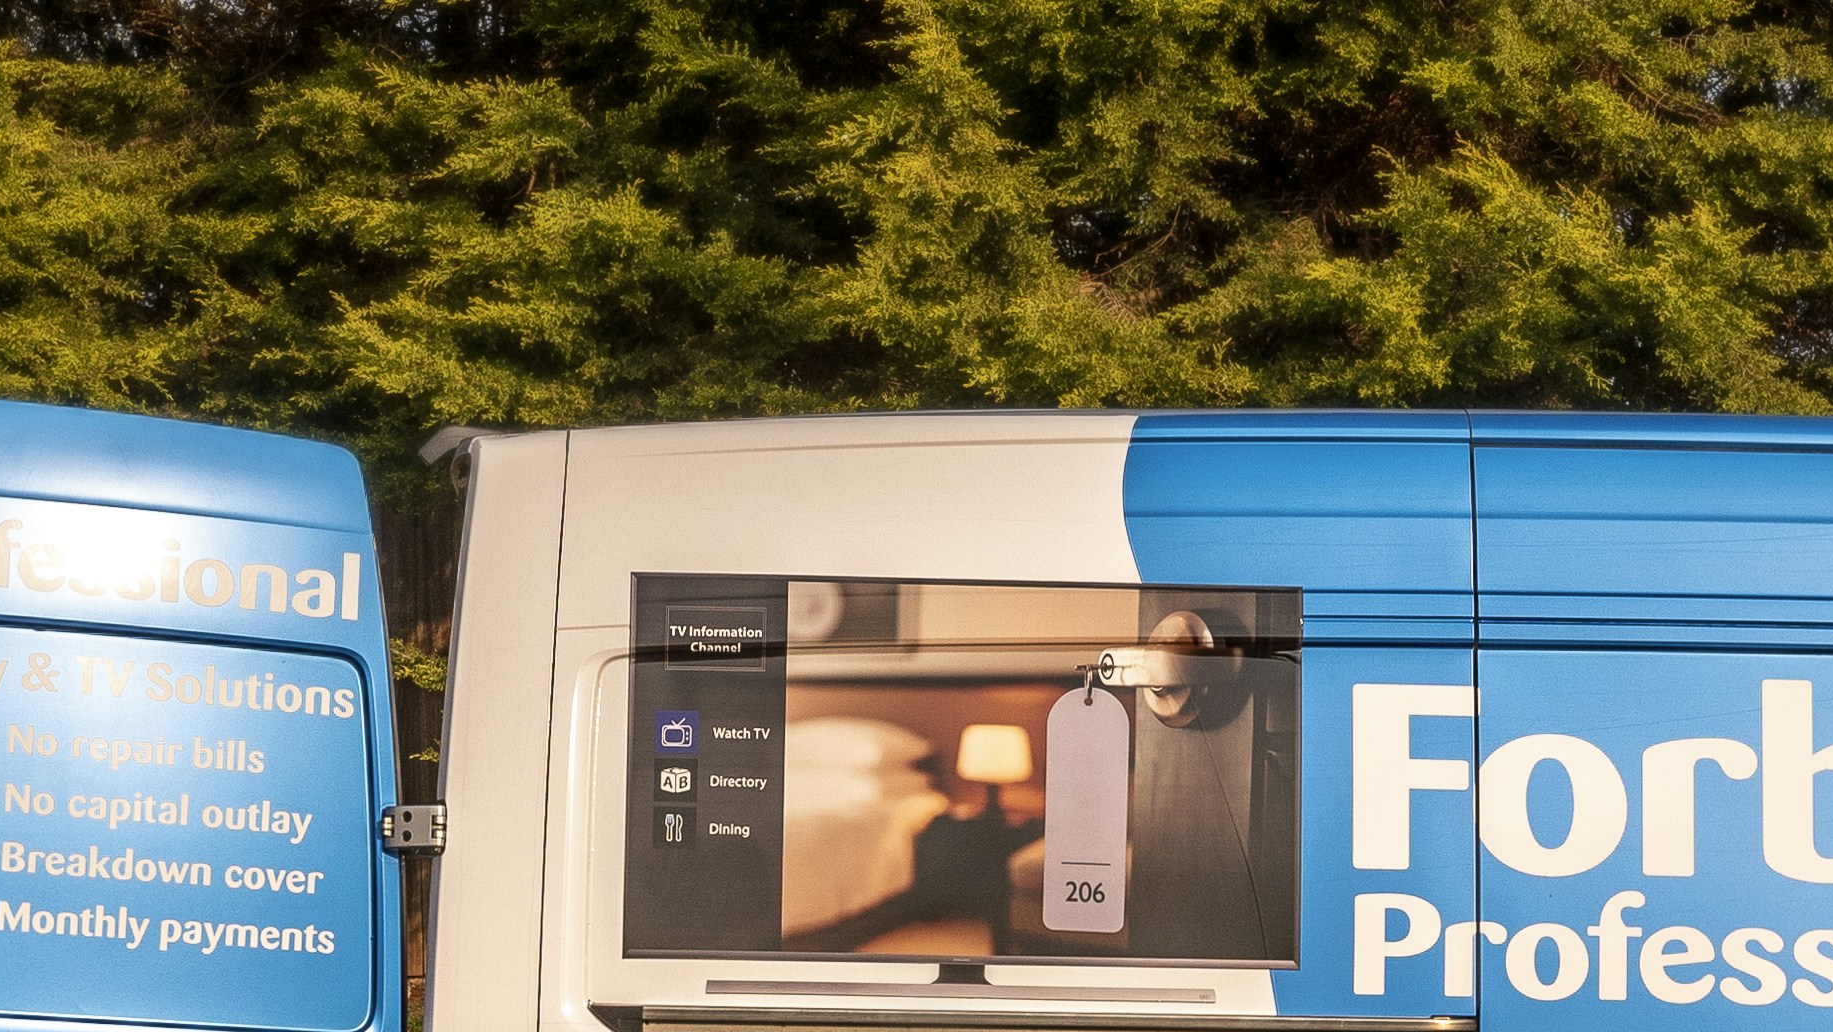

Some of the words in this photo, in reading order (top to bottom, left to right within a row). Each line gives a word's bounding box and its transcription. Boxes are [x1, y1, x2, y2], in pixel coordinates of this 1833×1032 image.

[670, 626, 686, 637] TV
[689, 625, 763, 638] Information
[690, 642, 741, 653] Channel
[20, 652, 59, 692] &
[76, 657, 135, 696] TV
[145, 663, 355, 718] Solutions
[713, 727, 750, 739] Watch
[754, 728, 770, 739] TV
[8, 724, 58, 756] No
[72, 732, 183, 770] repair
[192, 737, 265, 774] bills
[709, 775, 767, 790] Directory
[4, 783, 55, 815] No
[68, 788, 188, 828] capital
[201, 801, 313, 843] outlay
[709, 823, 750, 838] Dining
[0, 841, 211, 884] Breakdown
[224, 864, 324, 893] cover
[1065, 881, 1105, 905] 206
[159, 916, 335, 955] payments
